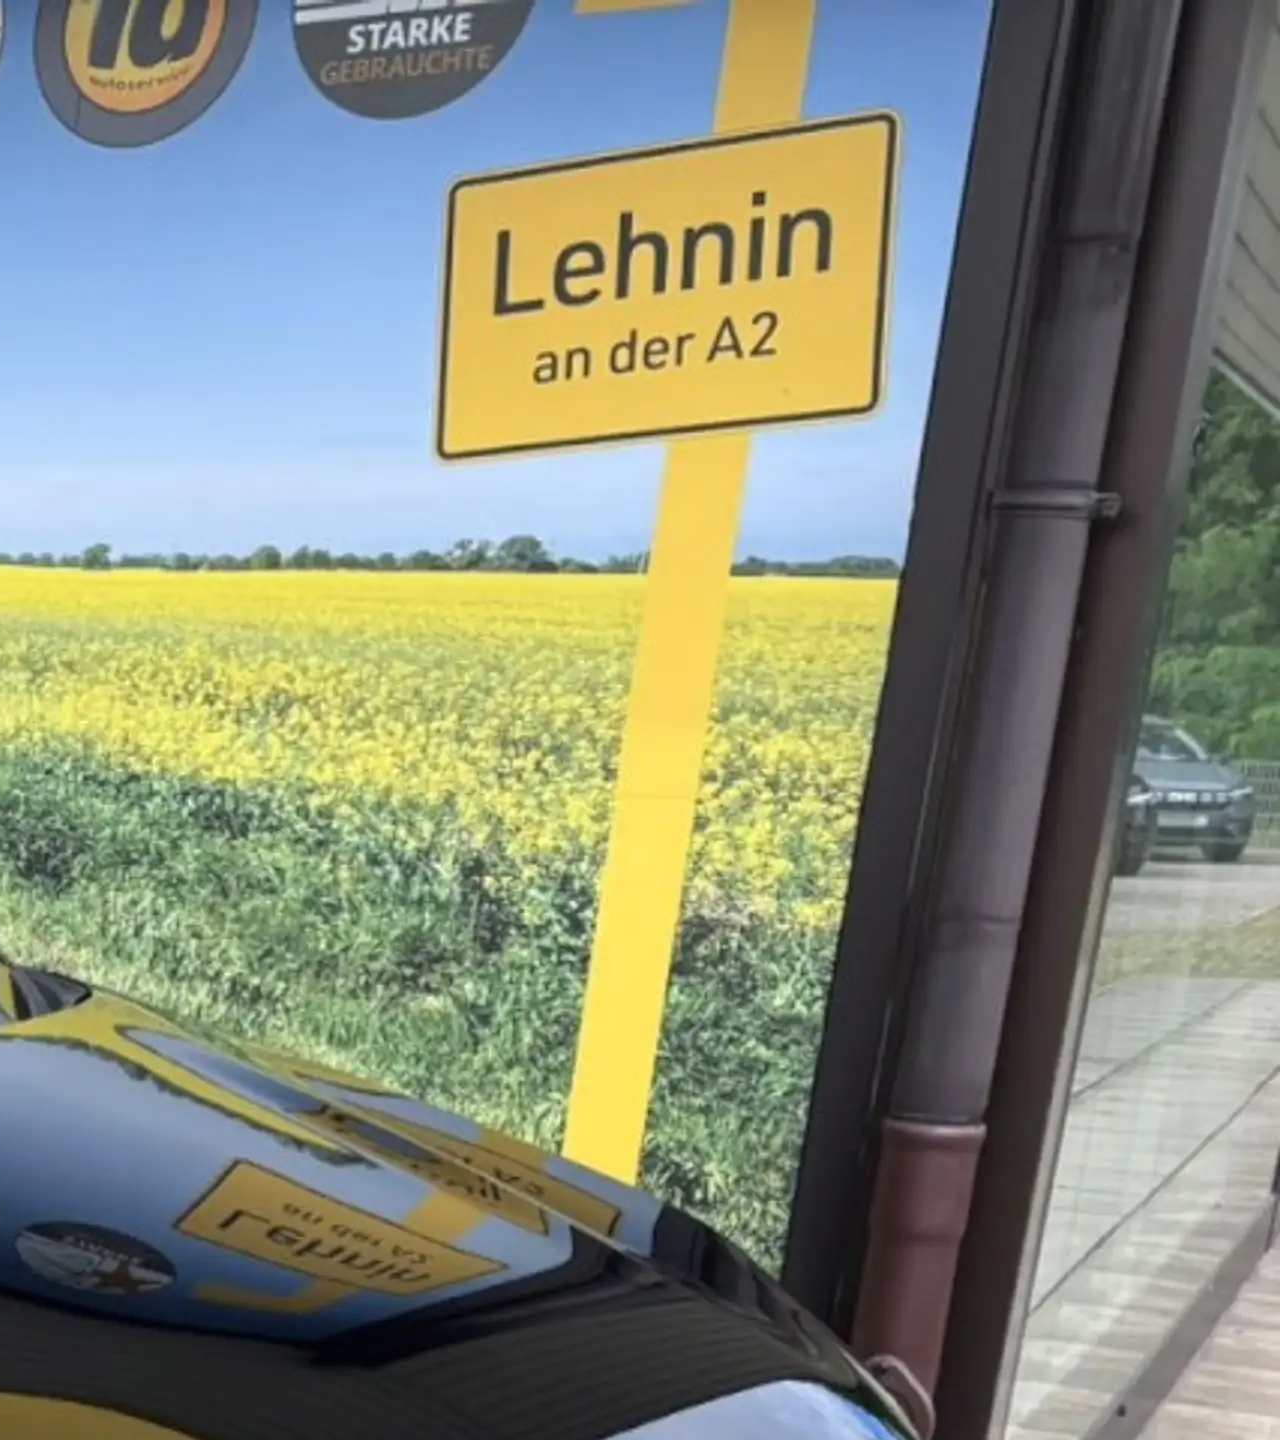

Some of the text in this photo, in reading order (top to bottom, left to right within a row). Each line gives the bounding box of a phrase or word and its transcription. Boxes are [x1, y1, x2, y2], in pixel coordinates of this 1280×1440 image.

[345, 12, 473, 55] STARKE
[319, 45, 496, 86] GEBRAUCHTE
[492, 190, 834, 317] Lehnin
[532, 310, 778, 385] an der A2
